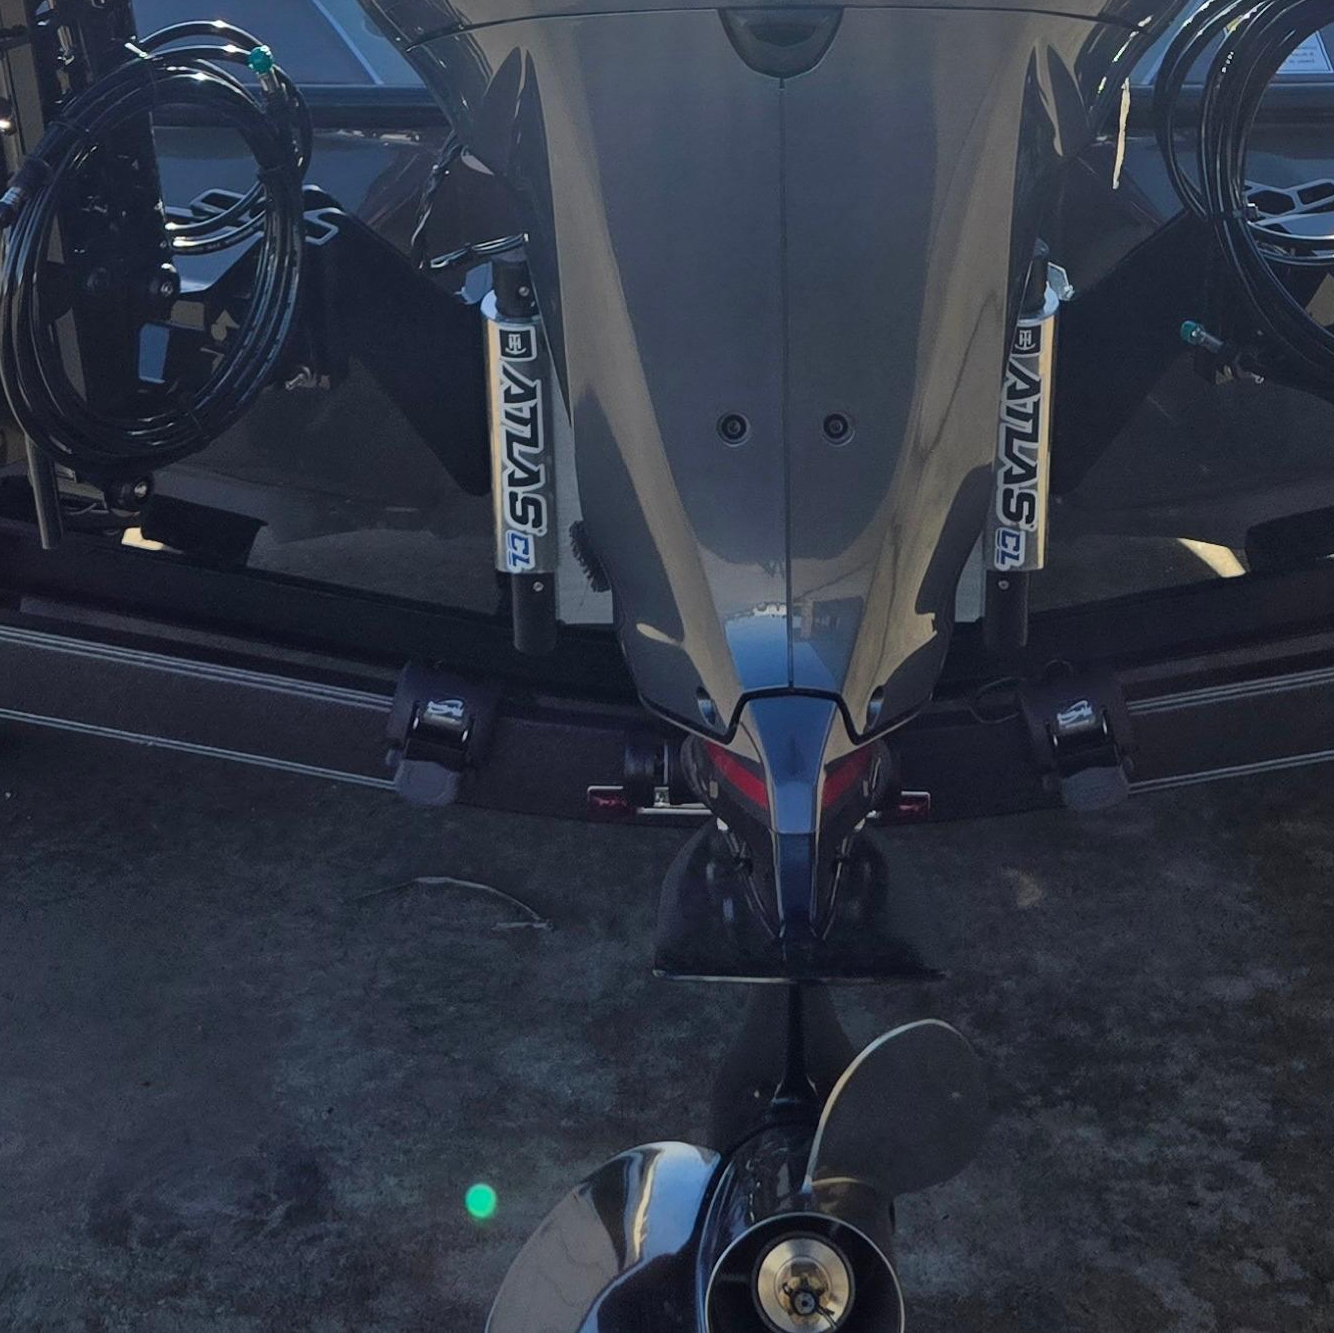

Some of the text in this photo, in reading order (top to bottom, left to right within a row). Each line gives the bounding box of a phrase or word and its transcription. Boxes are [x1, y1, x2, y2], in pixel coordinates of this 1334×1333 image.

[501, 362, 545, 568] ATLAS CL
[996, 360, 1043, 567] ATLAS CL
